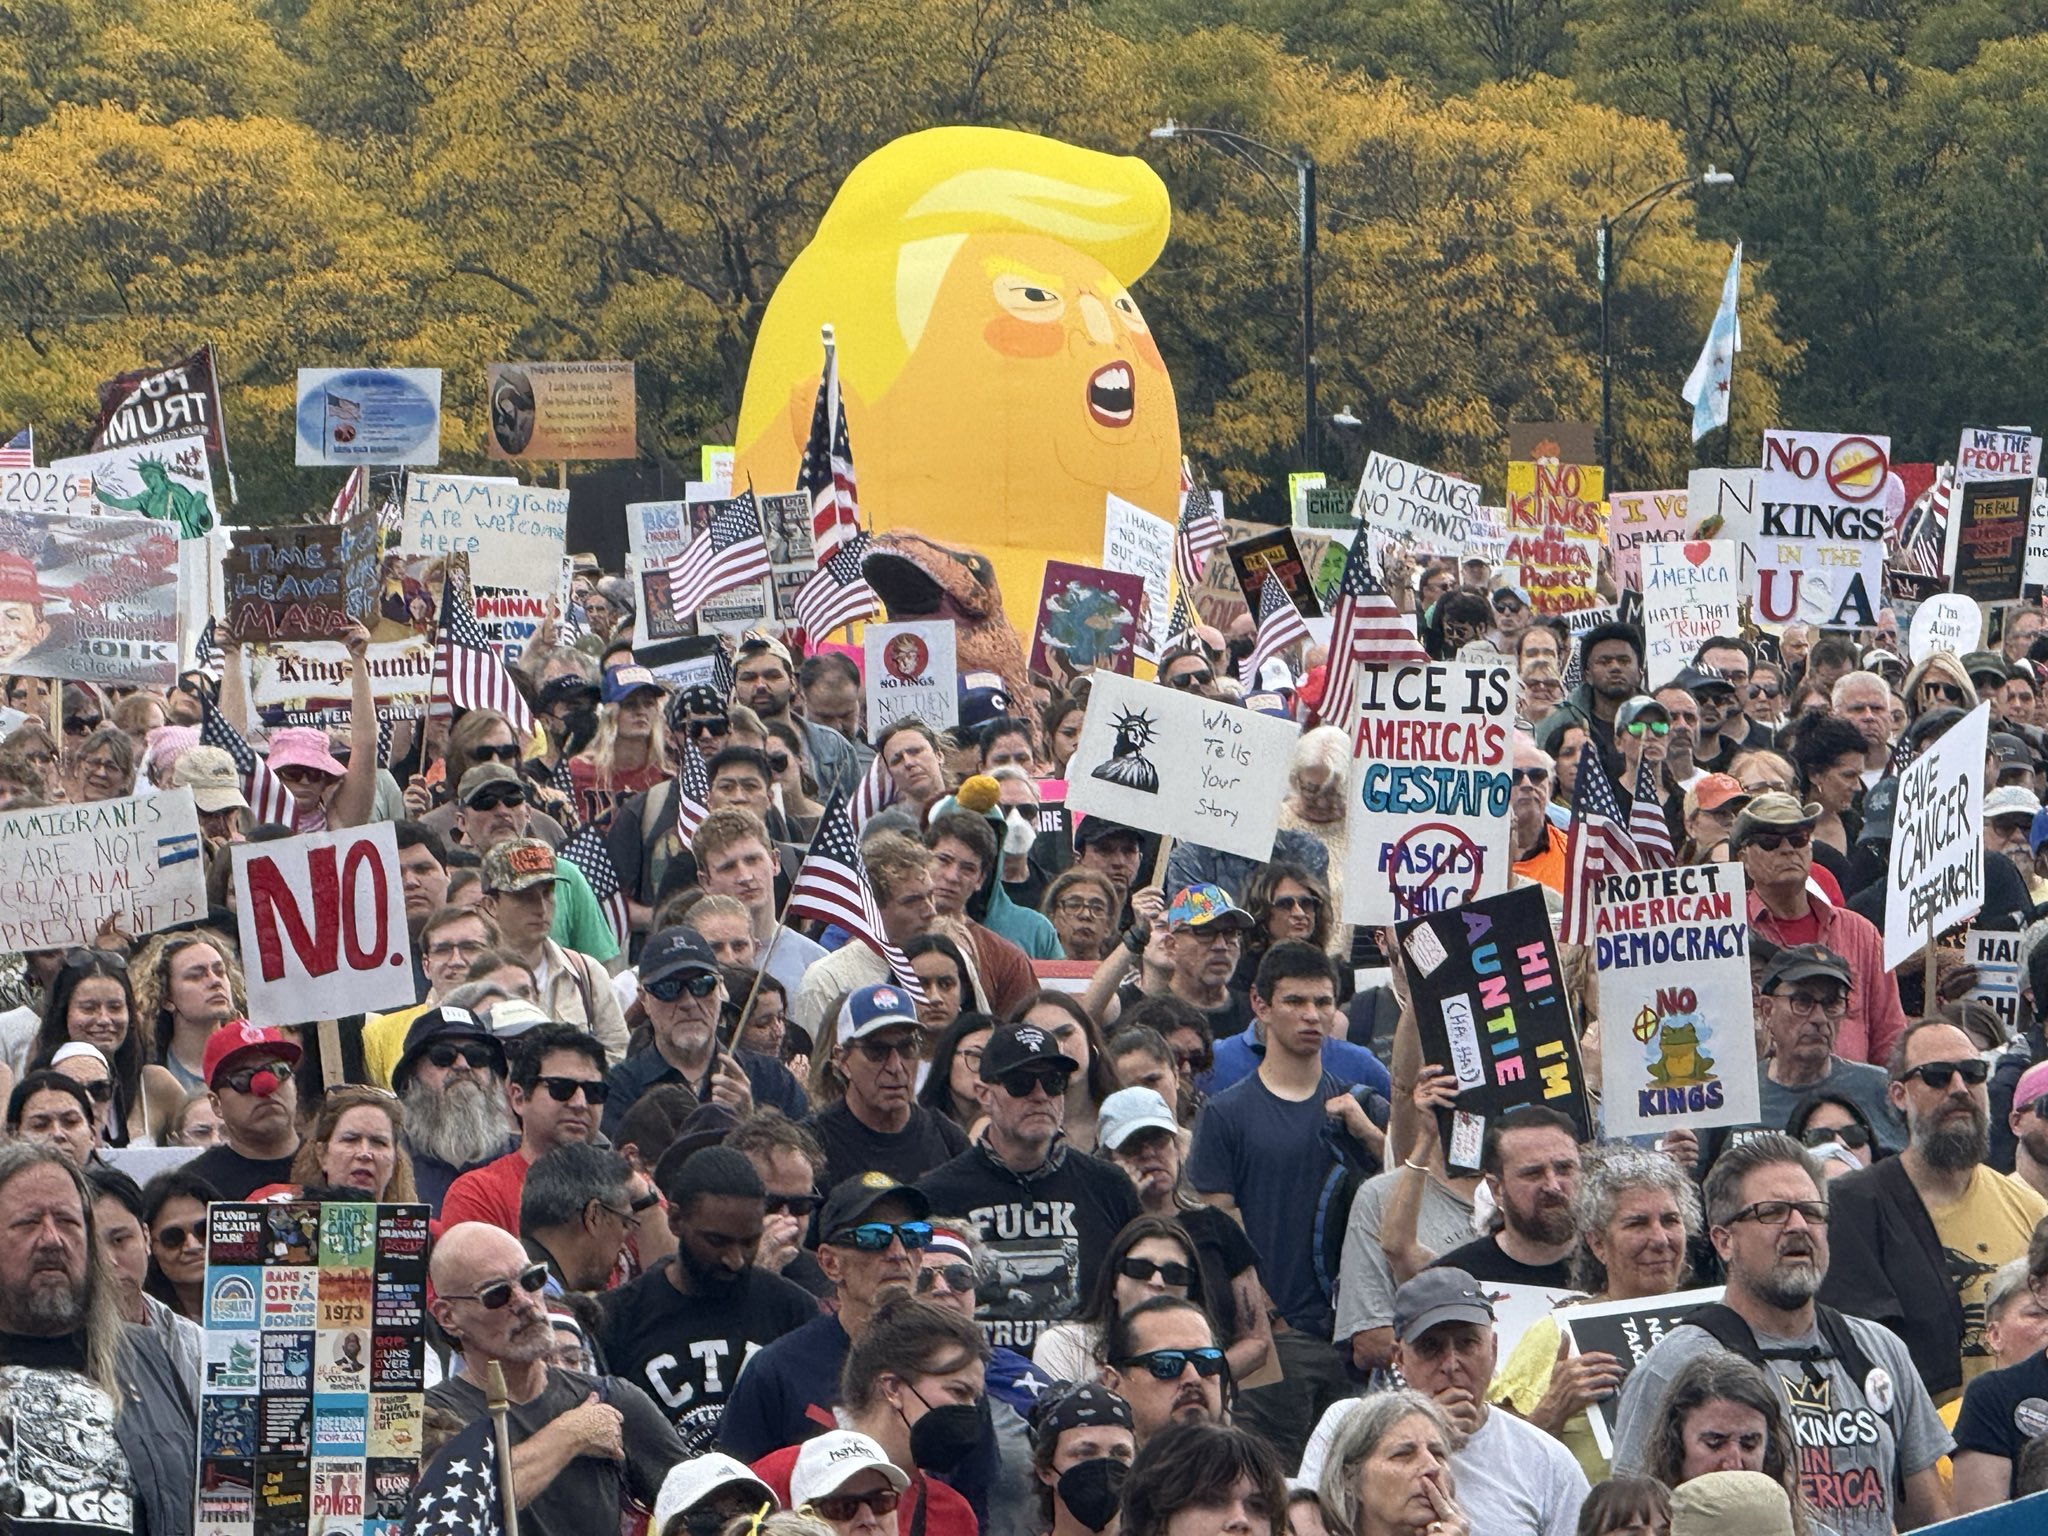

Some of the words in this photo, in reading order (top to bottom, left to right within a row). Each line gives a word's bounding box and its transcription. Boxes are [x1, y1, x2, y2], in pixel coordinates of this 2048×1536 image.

[1765, 437, 1820, 480] NO
[1974, 431, 1997, 450] WE
[2002, 435, 2032, 454] THE
[1963, 448, 2032, 475] PEOPLE
[7, 471, 78, 502] 2026
[1368, 457, 1406, 491] NO
[1411, 468, 1481, 517] KINGS
[1535, 464, 1581, 498] NO
[1359, 489, 1389, 516] NO
[1398, 497, 1472, 542] TYRANTS
[1509, 492, 1601, 535] KINGS
[1620, 499, 1648, 524] I
[1760, 502, 1885, 541] KINGS
[240, 544, 326, 574] TIME
[1650, 545, 1664, 565] I
[1777, 545, 1804, 565] IN
[1817, 546, 1862, 568] THE
[235, 569, 342, 600] LEAVE
[1649, 567, 1729, 590] AMERICA
[1758, 569, 1879, 626] USA
[1650, 607, 1688, 625] HATE
[1694, 604, 1730, 622] THAT
[1665, 621, 1722, 639] TRUMP
[366, 652, 431, 679] umb
[1362, 663, 1447, 713] ICE
[1461, 668, 1511, 716] IS
[1202, 709, 1243, 735] Who
[1204, 738, 1252, 767] Tells
[1353, 715, 1506, 766] AMERICA'S
[1201, 764, 1241, 790] Your
[1362, 763, 1513, 818] GESTAPO
[1899, 754, 1940, 829] SAVE
[3, 796, 162, 842] MMIGRANTS
[1194, 798, 1239, 827] Story
[1898, 773, 1971, 892] CANCER
[20, 842, 73, 881] ARE
[94, 831, 145, 867] NOT
[1378, 842, 1488, 875] FASCIST
[1, 862, 156, 909] CRIMINALS
[1595, 866, 1719, 904] PROTECT
[1907, 834, 1980, 938] RESEARCH!
[172, 893, 196, 922] IS
[247, 839, 404, 983] NO.
[1596, 892, 1733, 934] AMERICAN
[1597, 923, 1747, 970] DEMOCRACY
[1517, 940, 1556, 1010] HI!
[1460, 911, 1527, 1086] AUNTIE
[1656, 986, 1699, 1018] NO
[1535, 1040, 1573, 1100] I'M
[1638, 1080, 1724, 1119] KINGS
[213, 1211, 247, 1221] FUND
[213, 1221, 261, 1232] HEALTH
[968, 1201, 1079, 1240] FUCK
[213, 1232, 244, 1243] CARE
[265, 1285, 300, 1300] OFF
[264, 1314, 316, 1327] BODIES
[325, 1304, 364, 1321] 1973
[1790, 1411, 1879, 1446] KINGS
[1803, 1446, 1832, 1473] IN
[1797, 1467, 1885, 1508] ERICA
[314, 1494, 361, 1516] POWER
